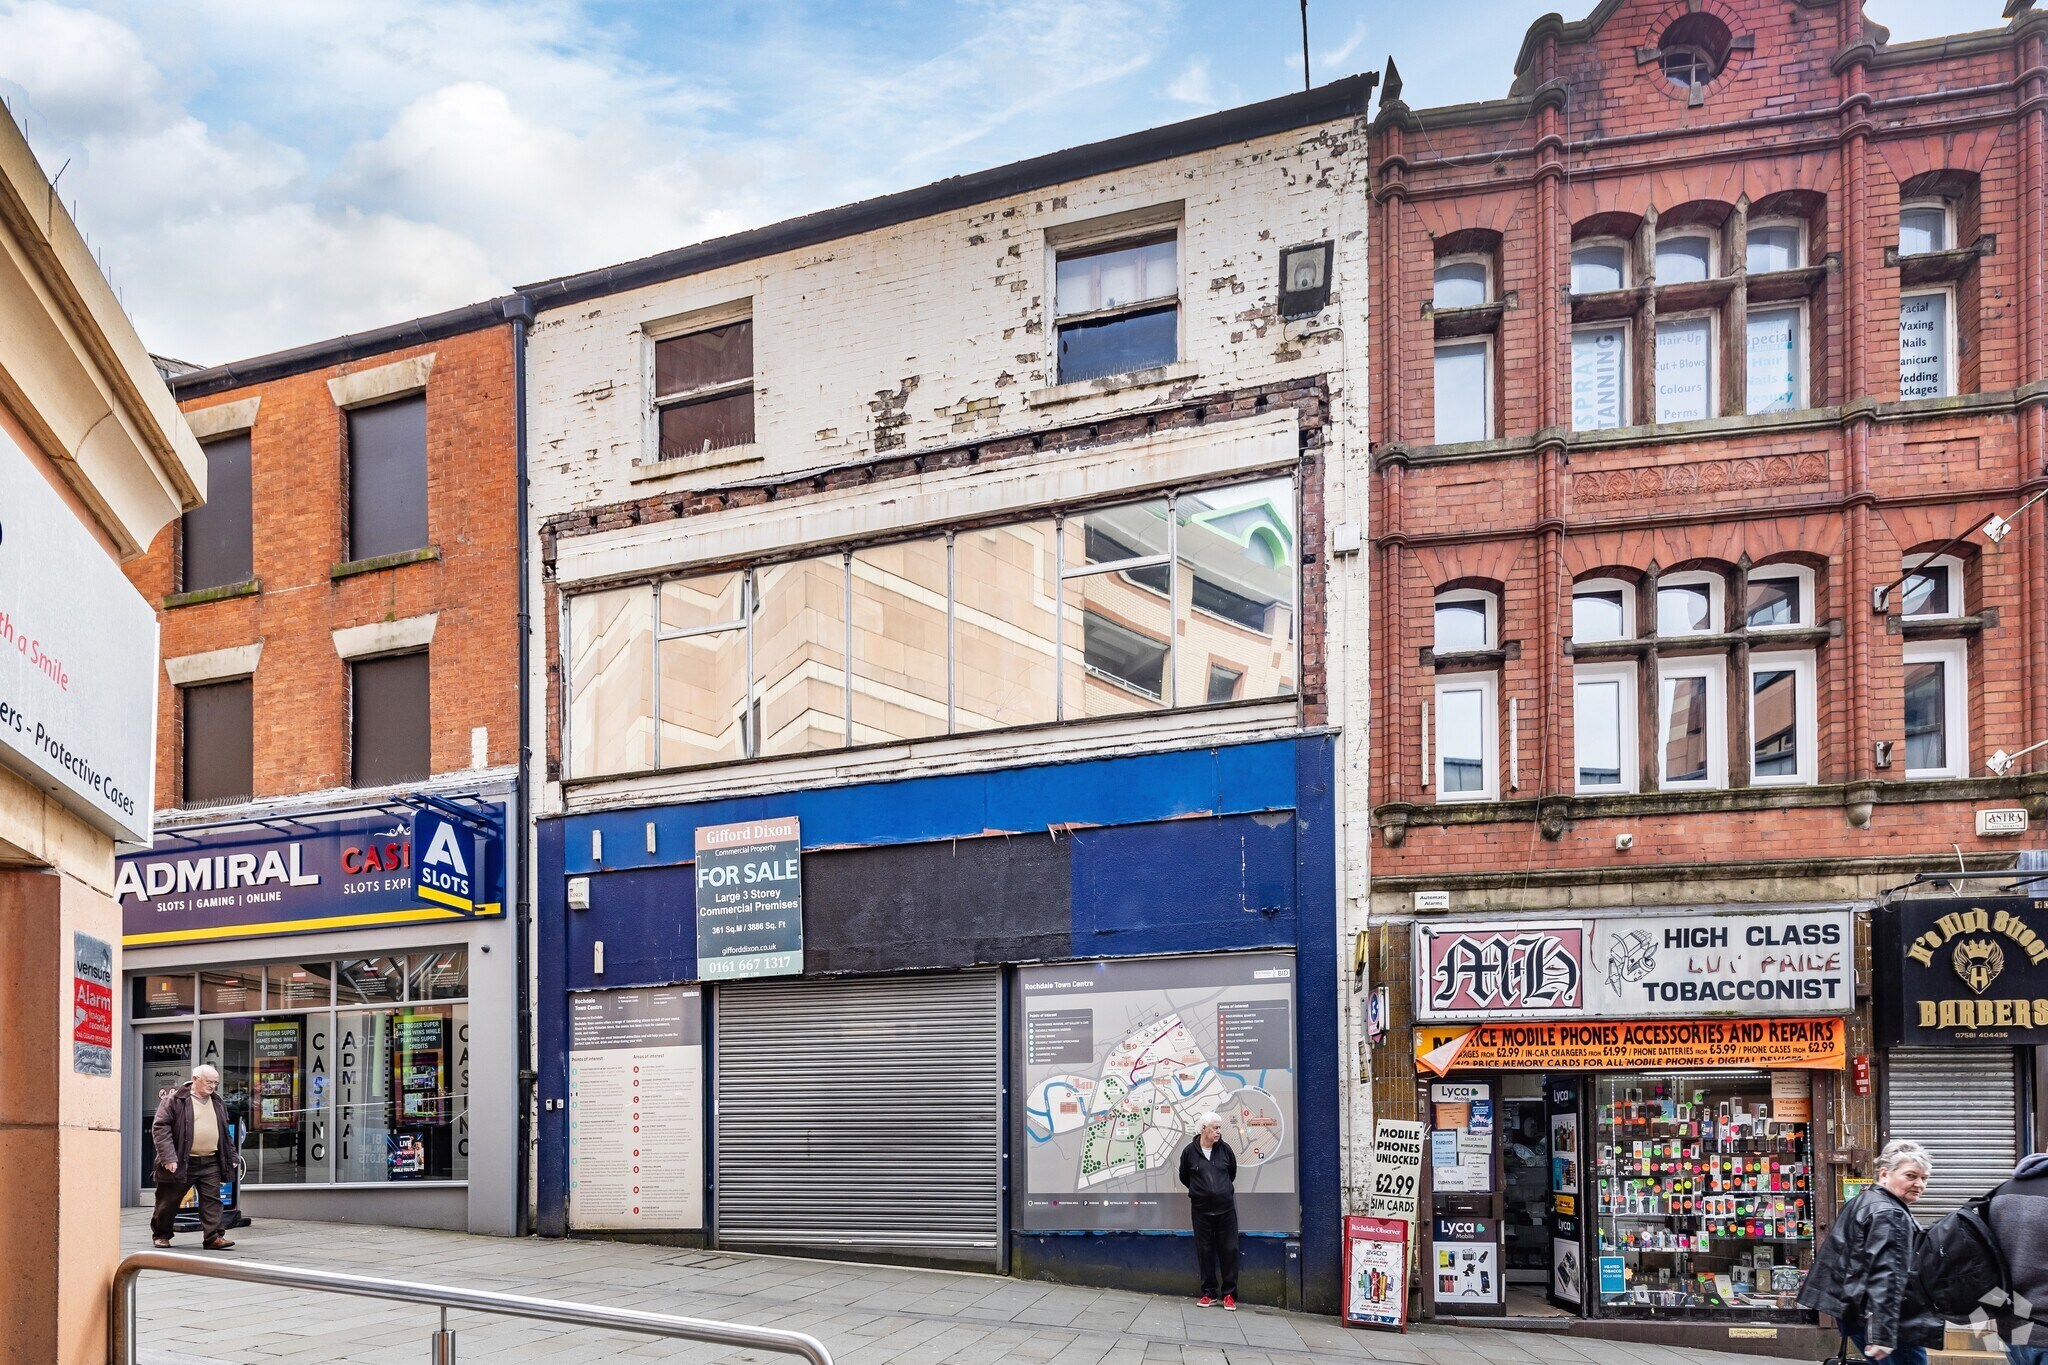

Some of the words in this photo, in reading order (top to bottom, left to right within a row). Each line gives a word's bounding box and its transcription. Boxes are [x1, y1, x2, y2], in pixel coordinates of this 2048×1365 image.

[1900, 302, 1928, 313] Facial
[1660, 334, 1701, 346] Hair-Up
[1902, 338, 1926, 348] Nails
[1680, 359, 1705, 368] Blows
[1596, 335, 1615, 429] TANNING
[1900, 372, 1938, 383] edding
[1574, 347, 1594, 425] SPRAY
[1660, 384, 1702, 395] Colours
[1664, 408, 1698, 419] Perms
[18, 635, 26, 655] a
[31, 640, 68, 691] Smile
[0, 702, 22, 732] ers
[35, 722, 101, 791] Protective
[104, 776, 134, 816] Cases
[1991, 812, 2021, 823] ASTRA
[707, 828, 750, 844] Gifford
[754, 825, 792, 838] Dixon
[423, 821, 468, 876] A
[715, 847, 749, 857] Commercial
[750, 844, 777, 853] Property
[113, 843, 319, 903] ADMIRAL
[698, 865, 740, 889] FOR
[744, 859, 798, 883] SALE
[344, 881, 379, 894] SLOTS
[422, 867, 469, 895] SLOTS
[157, 900, 185, 912] SLOTS
[196, 895, 235, 908] GAMING
[247, 891, 281, 903] ONLINE
[716, 892, 740, 903] Large
[743, 891, 748, 899] 3
[751, 889, 781, 899] Storey
[700, 902, 752, 917] Commercial
[755, 900, 798, 911] Premises
[1933, 908, 1991, 943] High
[1664, 927, 1728, 948] HIGH
[1746, 924, 1840, 946] CLASS
[722, 943, 777, 956] gifforddixon.co.uk
[709, 961, 735, 974] 0161
[739, 959, 761, 971] 667
[764, 956, 791, 969] 1317
[1643, 978, 1840, 1001] TOBACCONIST
[77, 984, 110, 1011] Alarm
[1917, 999, 2048, 1029] BARBERS
[1502, 1028, 1555, 1047] MOBILE
[1561, 1026, 1618, 1046] PHONES
[1623, 1023, 1723, 1045] ACCESSORIES
[1729, 1024, 1759, 1043] AND
[1769, 1021, 1833, 1042] REPAIRS
[1497, 1047, 1519, 1058] £2.99
[1525, 1049, 1549, 1057] IN-CAR
[1551, 1048, 1587, 1057] CHARGERS
[1603, 1047, 1627, 1056] £1.99
[1634, 1048, 1657, 1056] PHONE
[1658, 1047, 1694, 1055] BATTERIES
[1710, 1044, 1737, 1054] £5.99
[1743, 1046, 1768, 1054] PHONE
[1769, 1045, 1791, 1054] CASES
[1808, 1042, 1834, 1053] £2.99
[1502, 1059, 1544, 1067] MEMORY
[1547, 1059, 1581, 1067] CARDS
[1583, 1058, 1603, 1067] FOR
[1606, 1058, 1622, 1066] ALL
[1665, 1057, 1704, 1065] PHONES
[1717, 1056, 1755, 1064] DIGITAL
[311, 1033, 325, 1161] CASINO
[342, 1031, 357, 1160] ADMIRAL
[1442, 1086, 1469, 1098] Lyca
[1554, 1089, 1569, 1103] Lyca
[1380, 1128, 1419, 1140] MOBILE
[1377, 1141, 1420, 1153] PHONES
[1376, 1154, 1419, 1165] UNLOCKED
[1376, 1174, 1414, 1195] £2.99
[1371, 1199, 1384, 1210] SIM
[1387, 1200, 1414, 1212] CARDS
[1351, 1224, 1375, 1233] Rochdale
[1376, 1227, 1401, 1235] Observer
[1441, 1220, 1475, 1235] Lyca
[1558, 1219, 1571, 1231] Lyca
